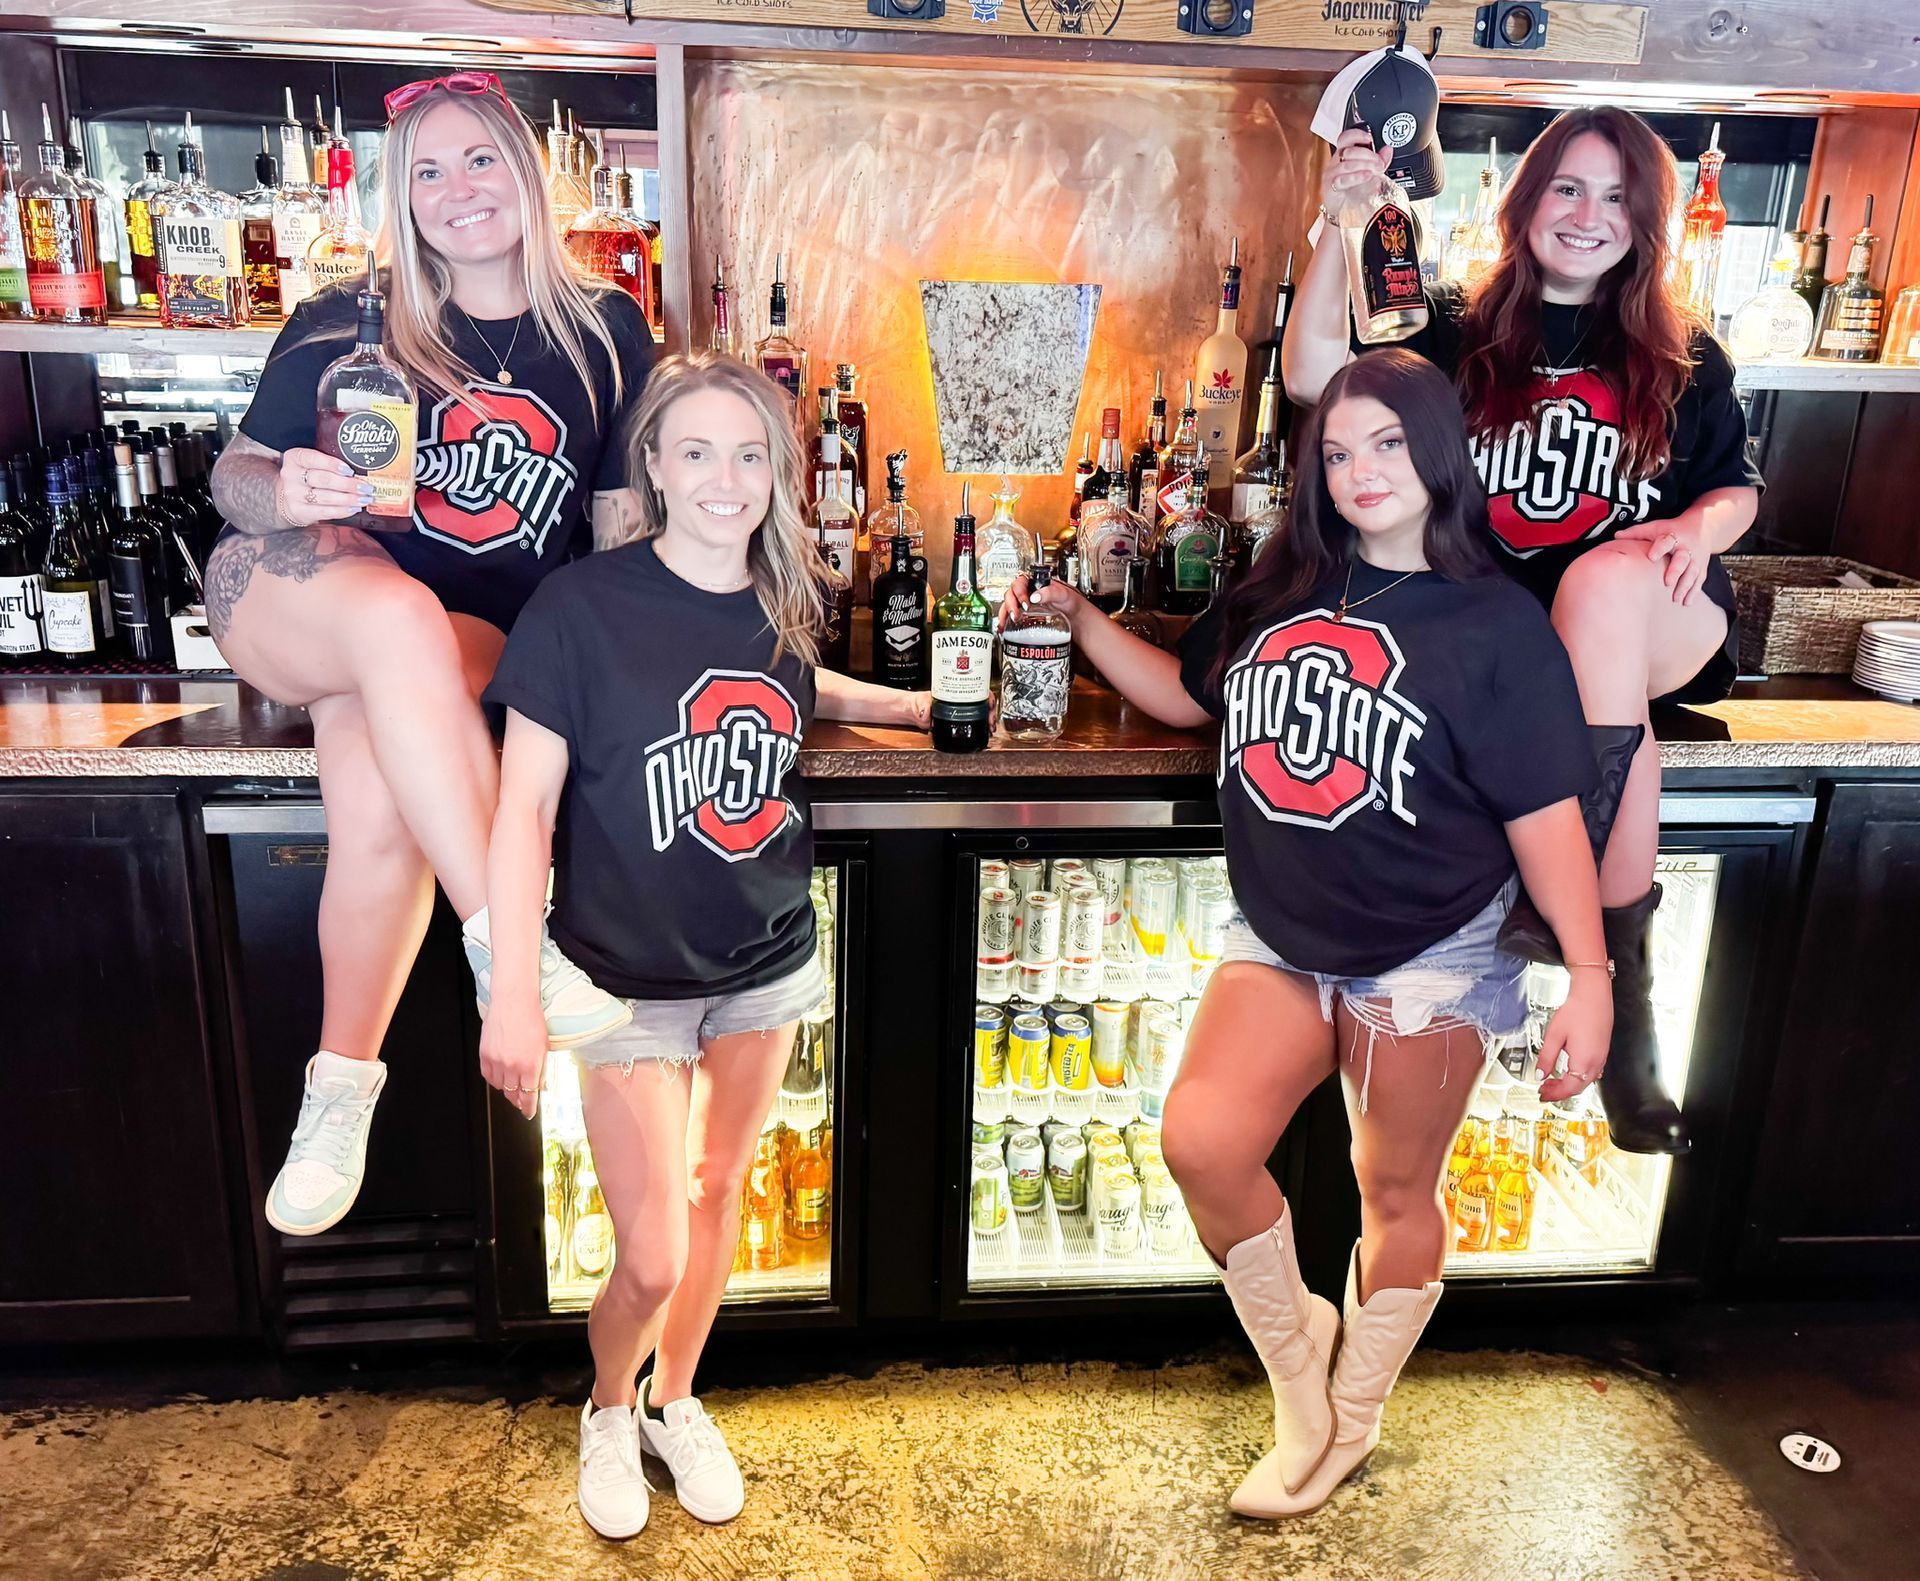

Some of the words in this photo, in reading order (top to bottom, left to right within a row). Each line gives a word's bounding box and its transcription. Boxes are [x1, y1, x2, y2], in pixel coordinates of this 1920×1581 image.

[1334, 24, 1349, 36] ICE
[1351, 26, 1375, 37] COLD
[1392, 124, 1409, 136] KP
[166, 225, 211, 246] KNOB
[176, 246, 221, 254] CREEK
[219, 255, 226, 269] 9
[361, 419, 379, 431] Ole
[341, 424, 395, 446] Smoky
[351, 445, 388, 454] Tennessee
[889, 592, 917, 611] Mash
[49, 609, 82, 630] Cupcake
[888, 606, 923, 626] Mallow
[936, 636, 990, 649] JAMESON
[1020, 646, 1056, 659] ESPOLÓN
[1286, 656, 1425, 827] STATE
[645, 733, 727, 853] OHIO
